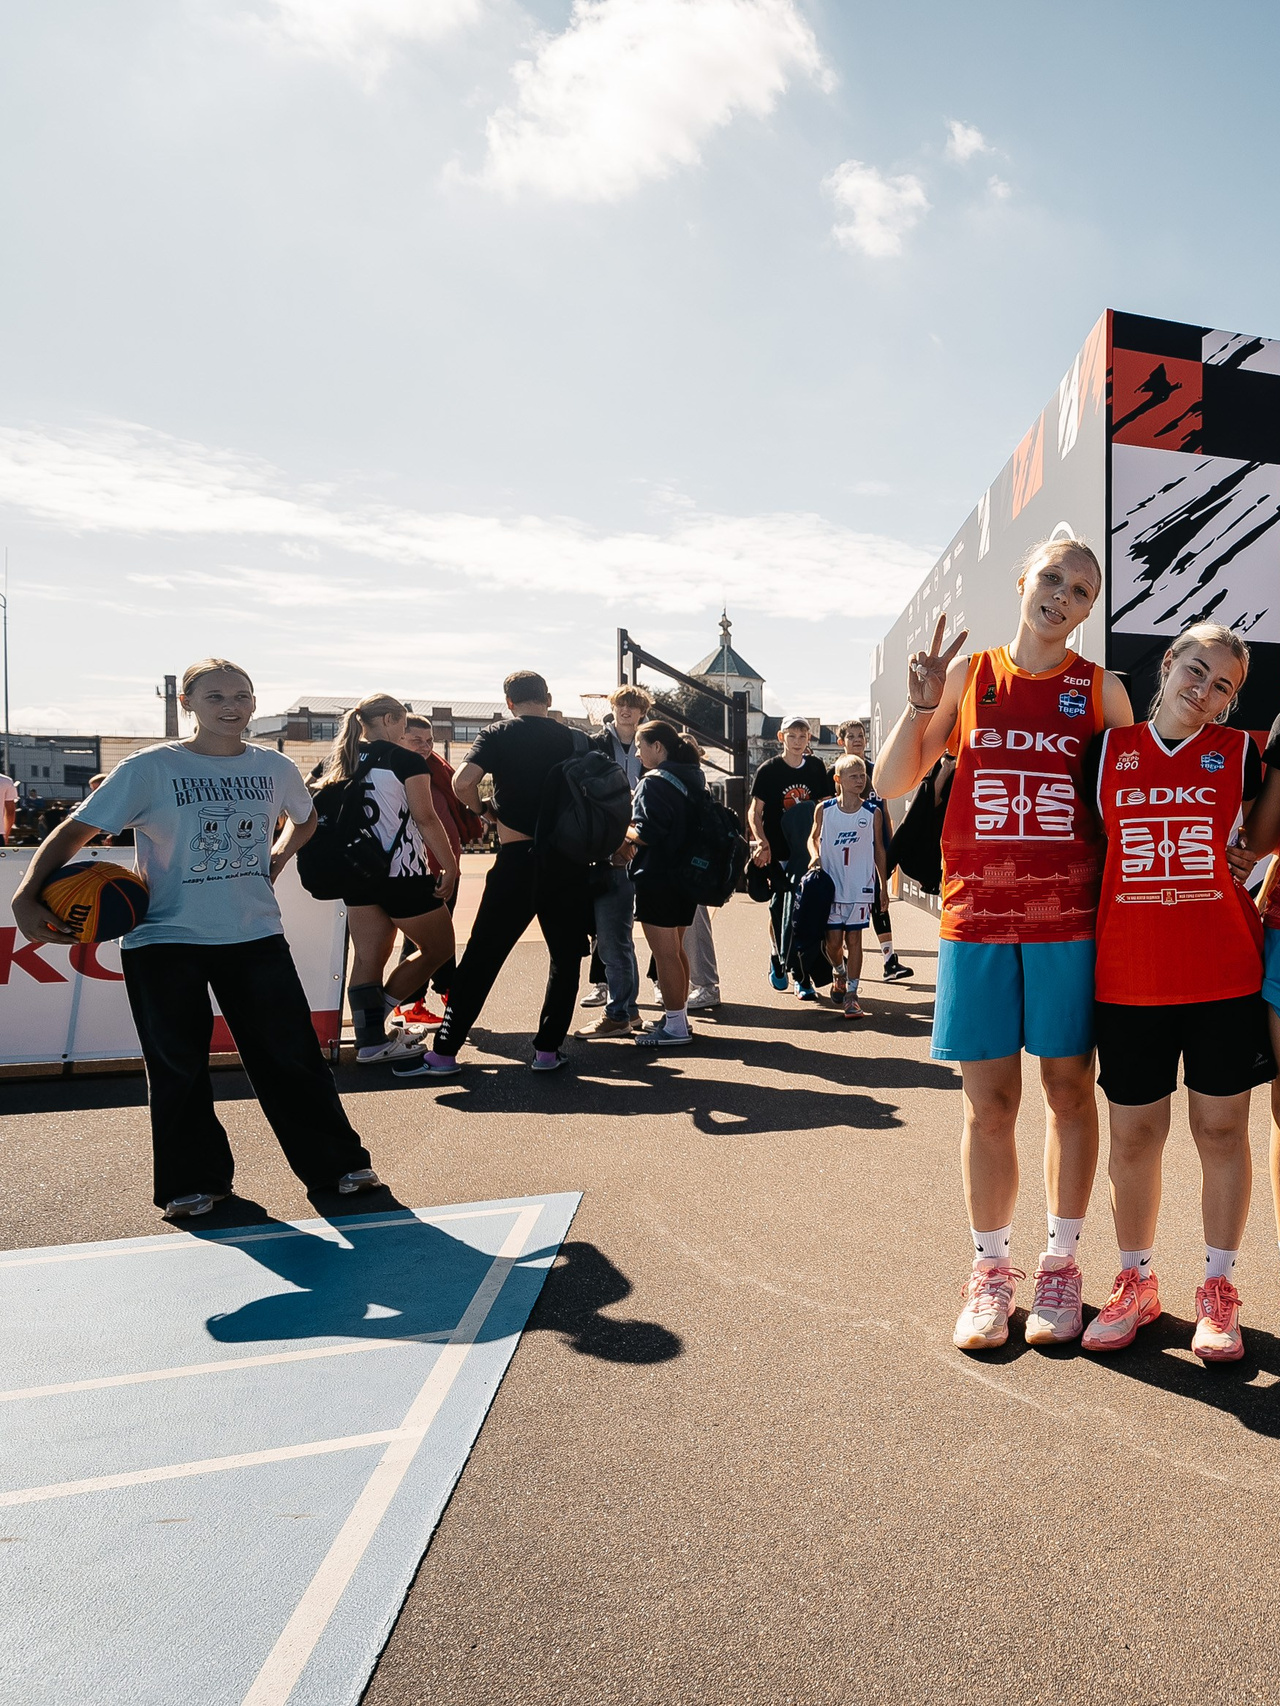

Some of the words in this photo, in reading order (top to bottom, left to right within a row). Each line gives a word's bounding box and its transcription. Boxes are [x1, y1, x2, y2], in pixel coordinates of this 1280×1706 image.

[1058, 704, 1086, 715] ТВЕРЬ
[1006, 729, 1080, 757] DKC
[1115, 760, 1139, 771] 890
[172, 778, 178, 792] I
[180, 777, 218, 790] FEEL
[220, 776, 274, 789] MATCHA
[175, 786, 234, 807] BETTER
[1149, 786, 1217, 805] DKC
[842, 847, 850, 866] 1
[225, 871, 239, 879] and
[859, 906, 865, 920] 1
